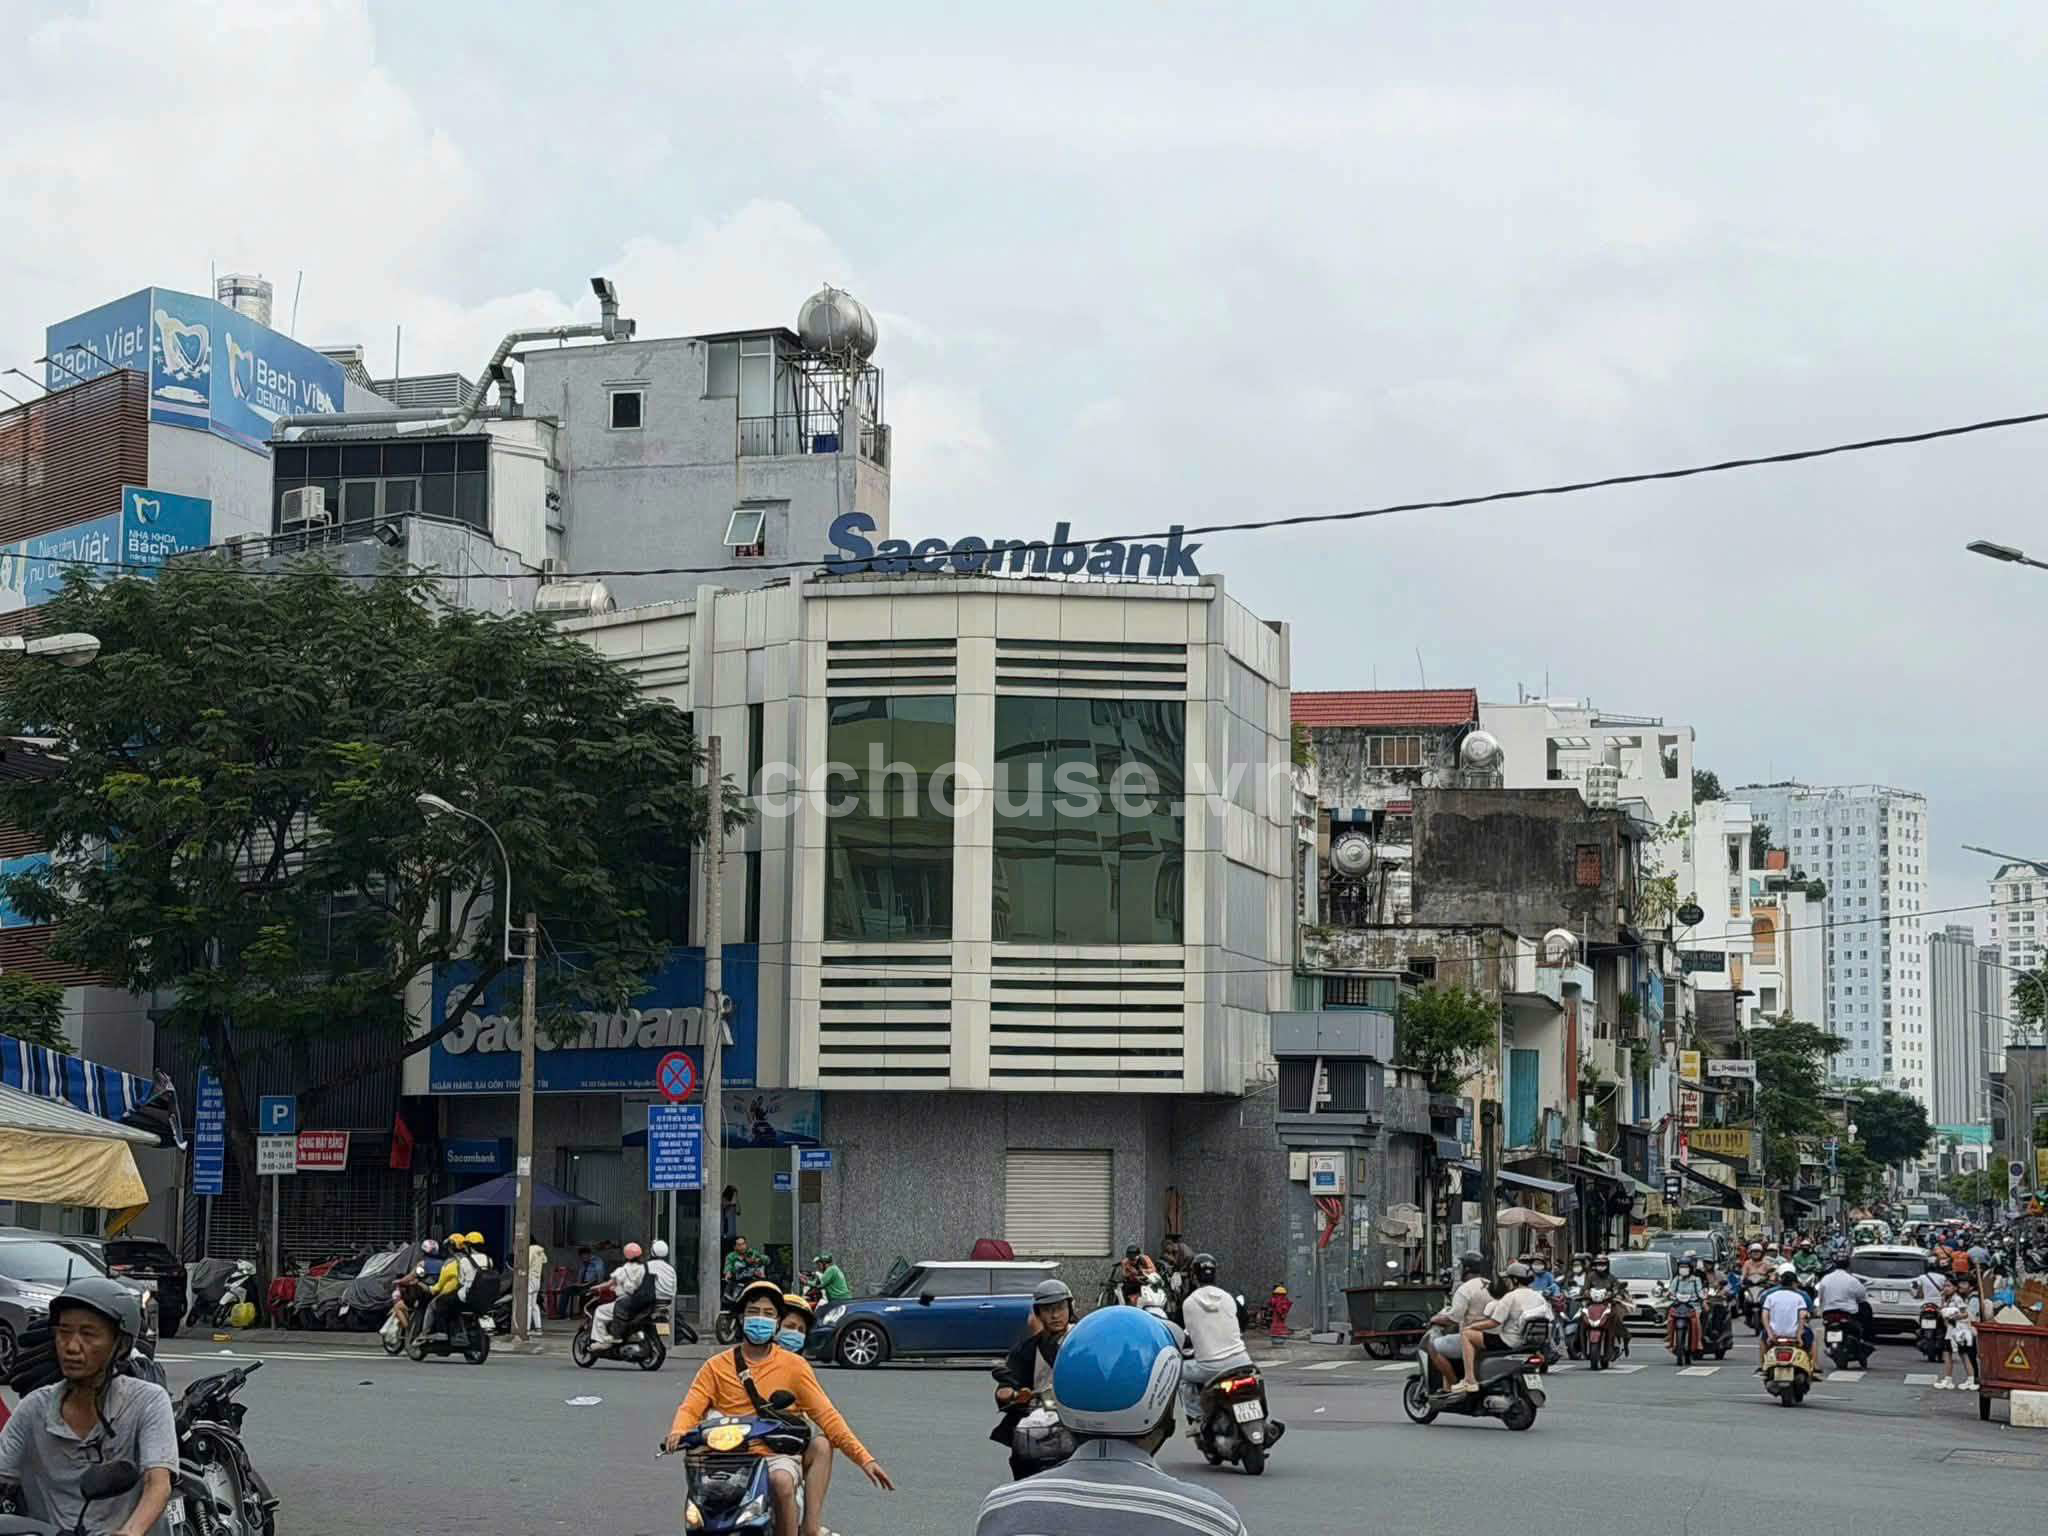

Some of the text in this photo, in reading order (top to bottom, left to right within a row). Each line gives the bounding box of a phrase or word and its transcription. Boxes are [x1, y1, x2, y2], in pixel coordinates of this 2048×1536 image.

[257, 358, 333, 413] Bach Vie
[151, 532, 177, 543] KHOA
[824, 511, 1202, 577] Sacombank
[272, 1104, 289, 1125] P
[447, 1149, 497, 1163] Sacombank
